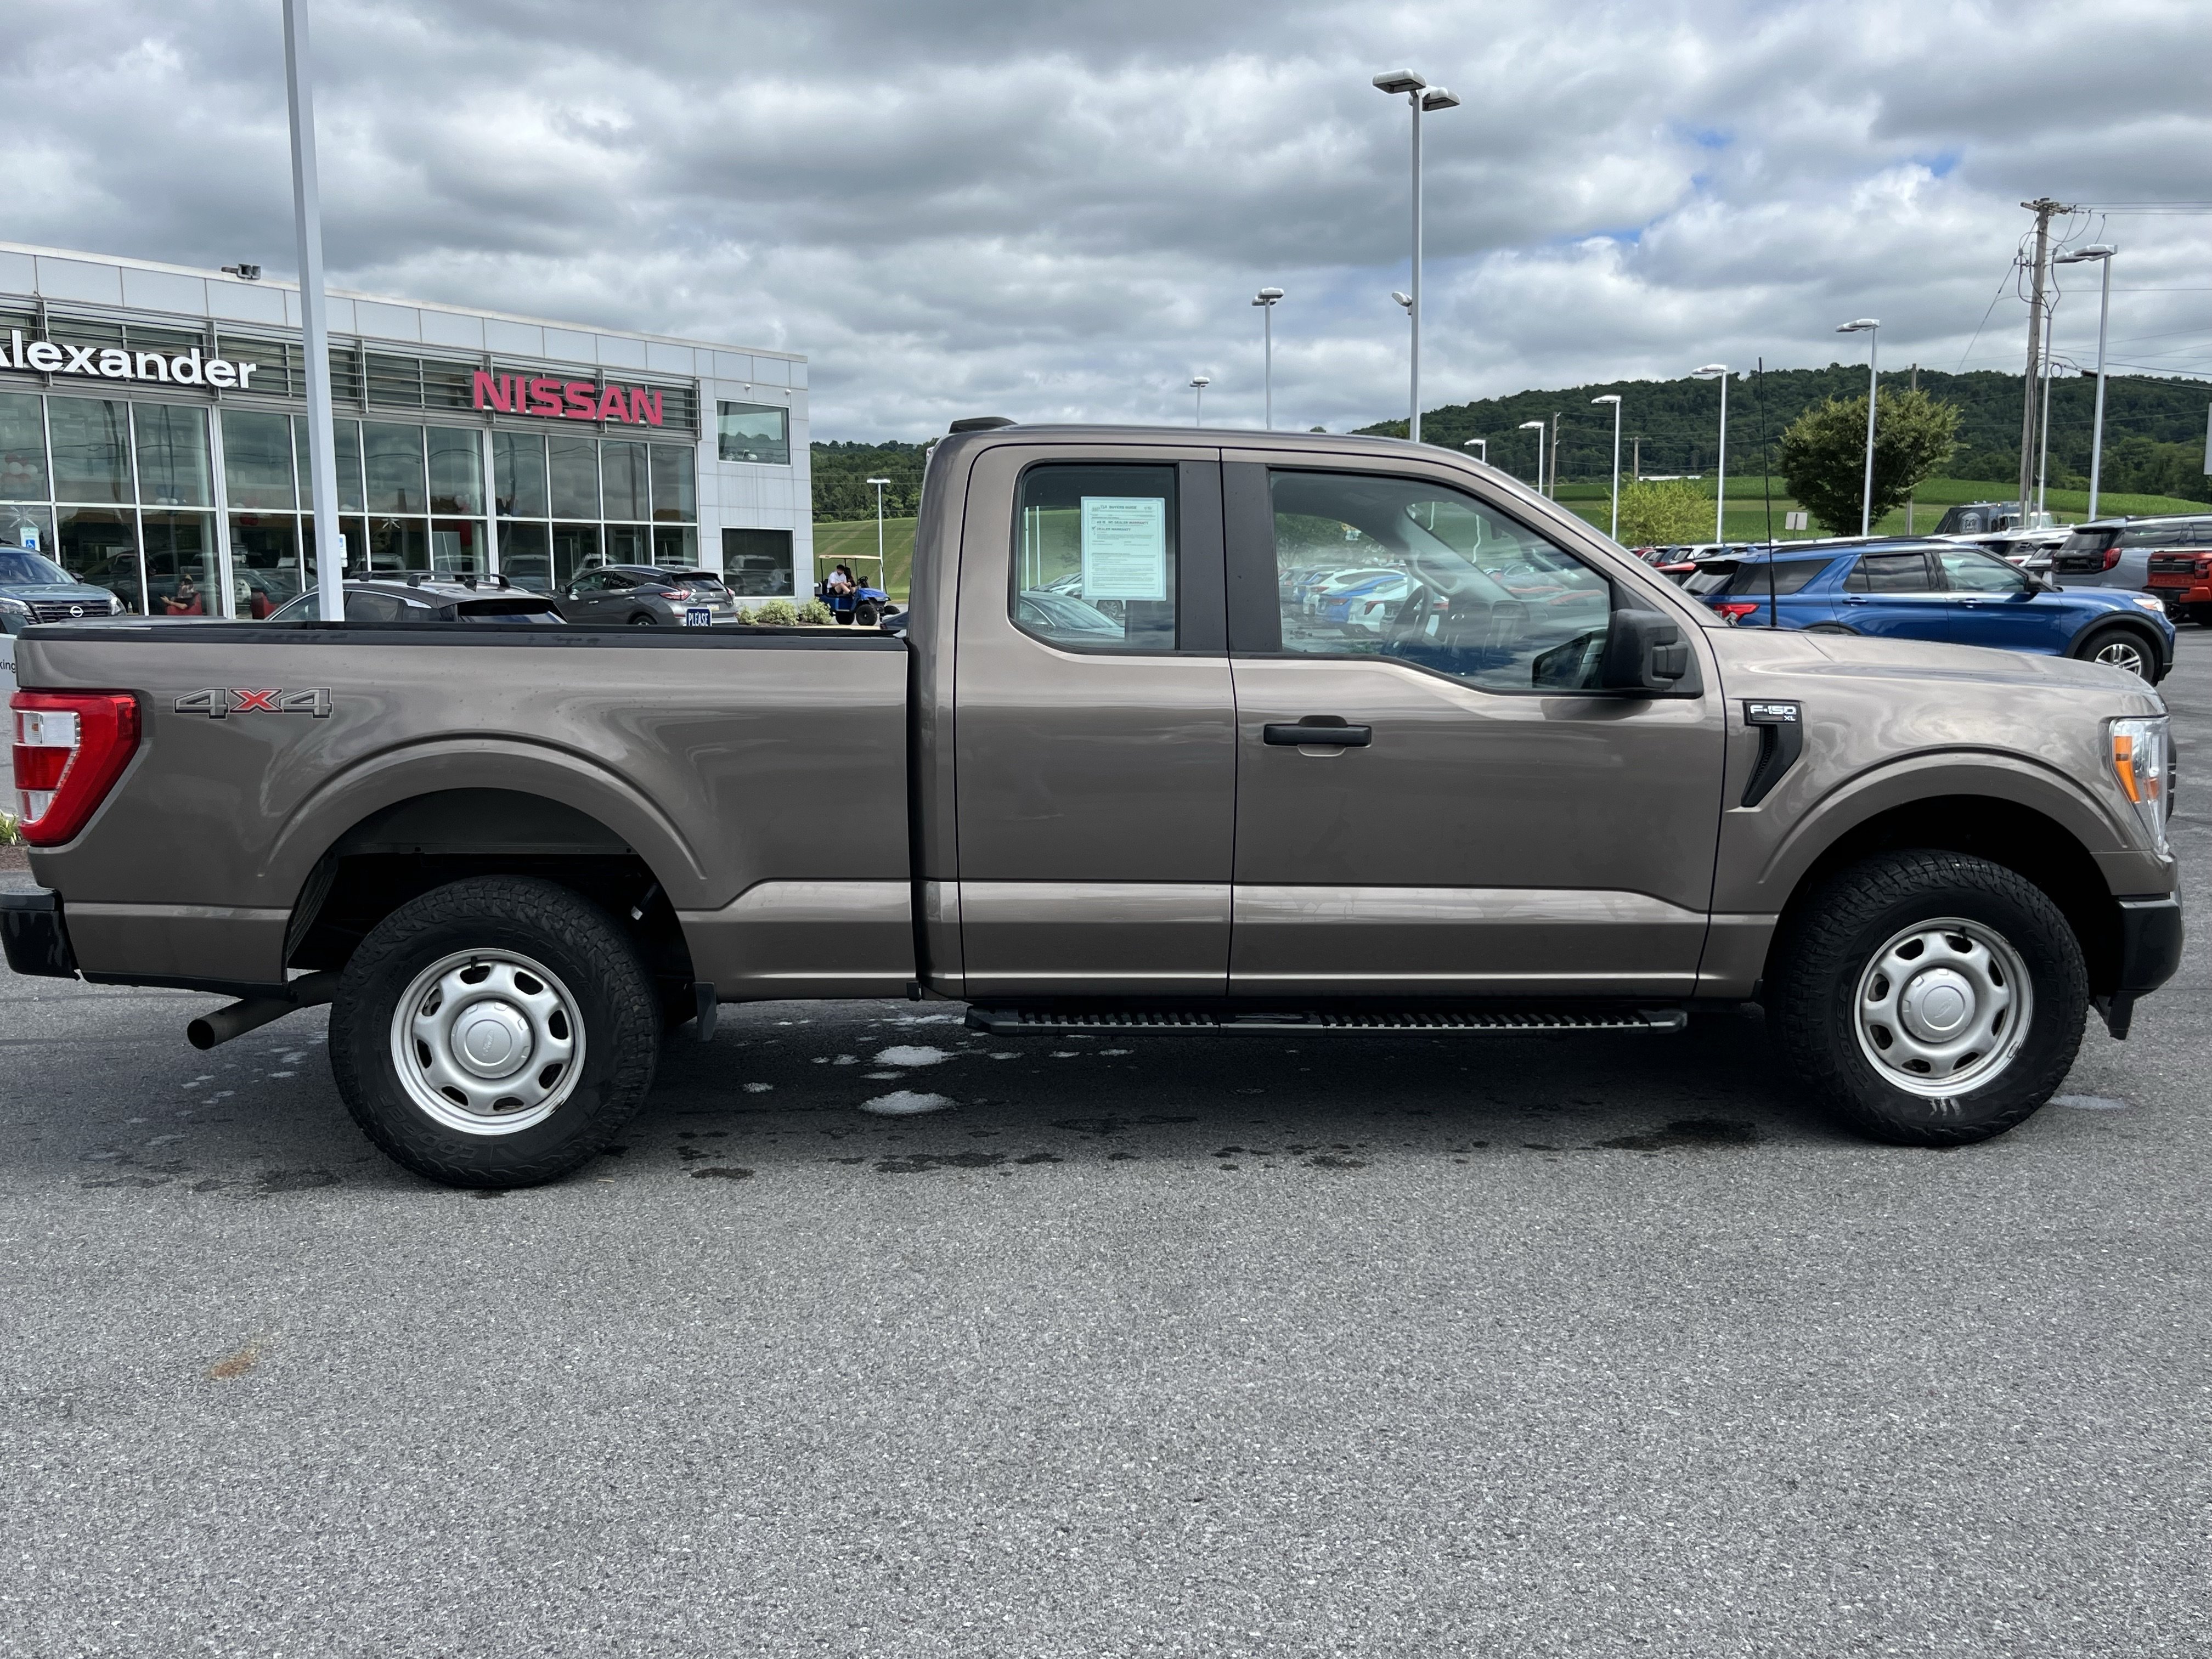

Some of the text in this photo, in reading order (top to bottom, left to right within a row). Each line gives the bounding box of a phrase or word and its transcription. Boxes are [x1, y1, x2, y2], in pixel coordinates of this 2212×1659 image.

[473, 371, 663, 426] NISSAN
[688, 612, 709, 627] PLEASE
[1750, 704, 1797, 715] F-150
